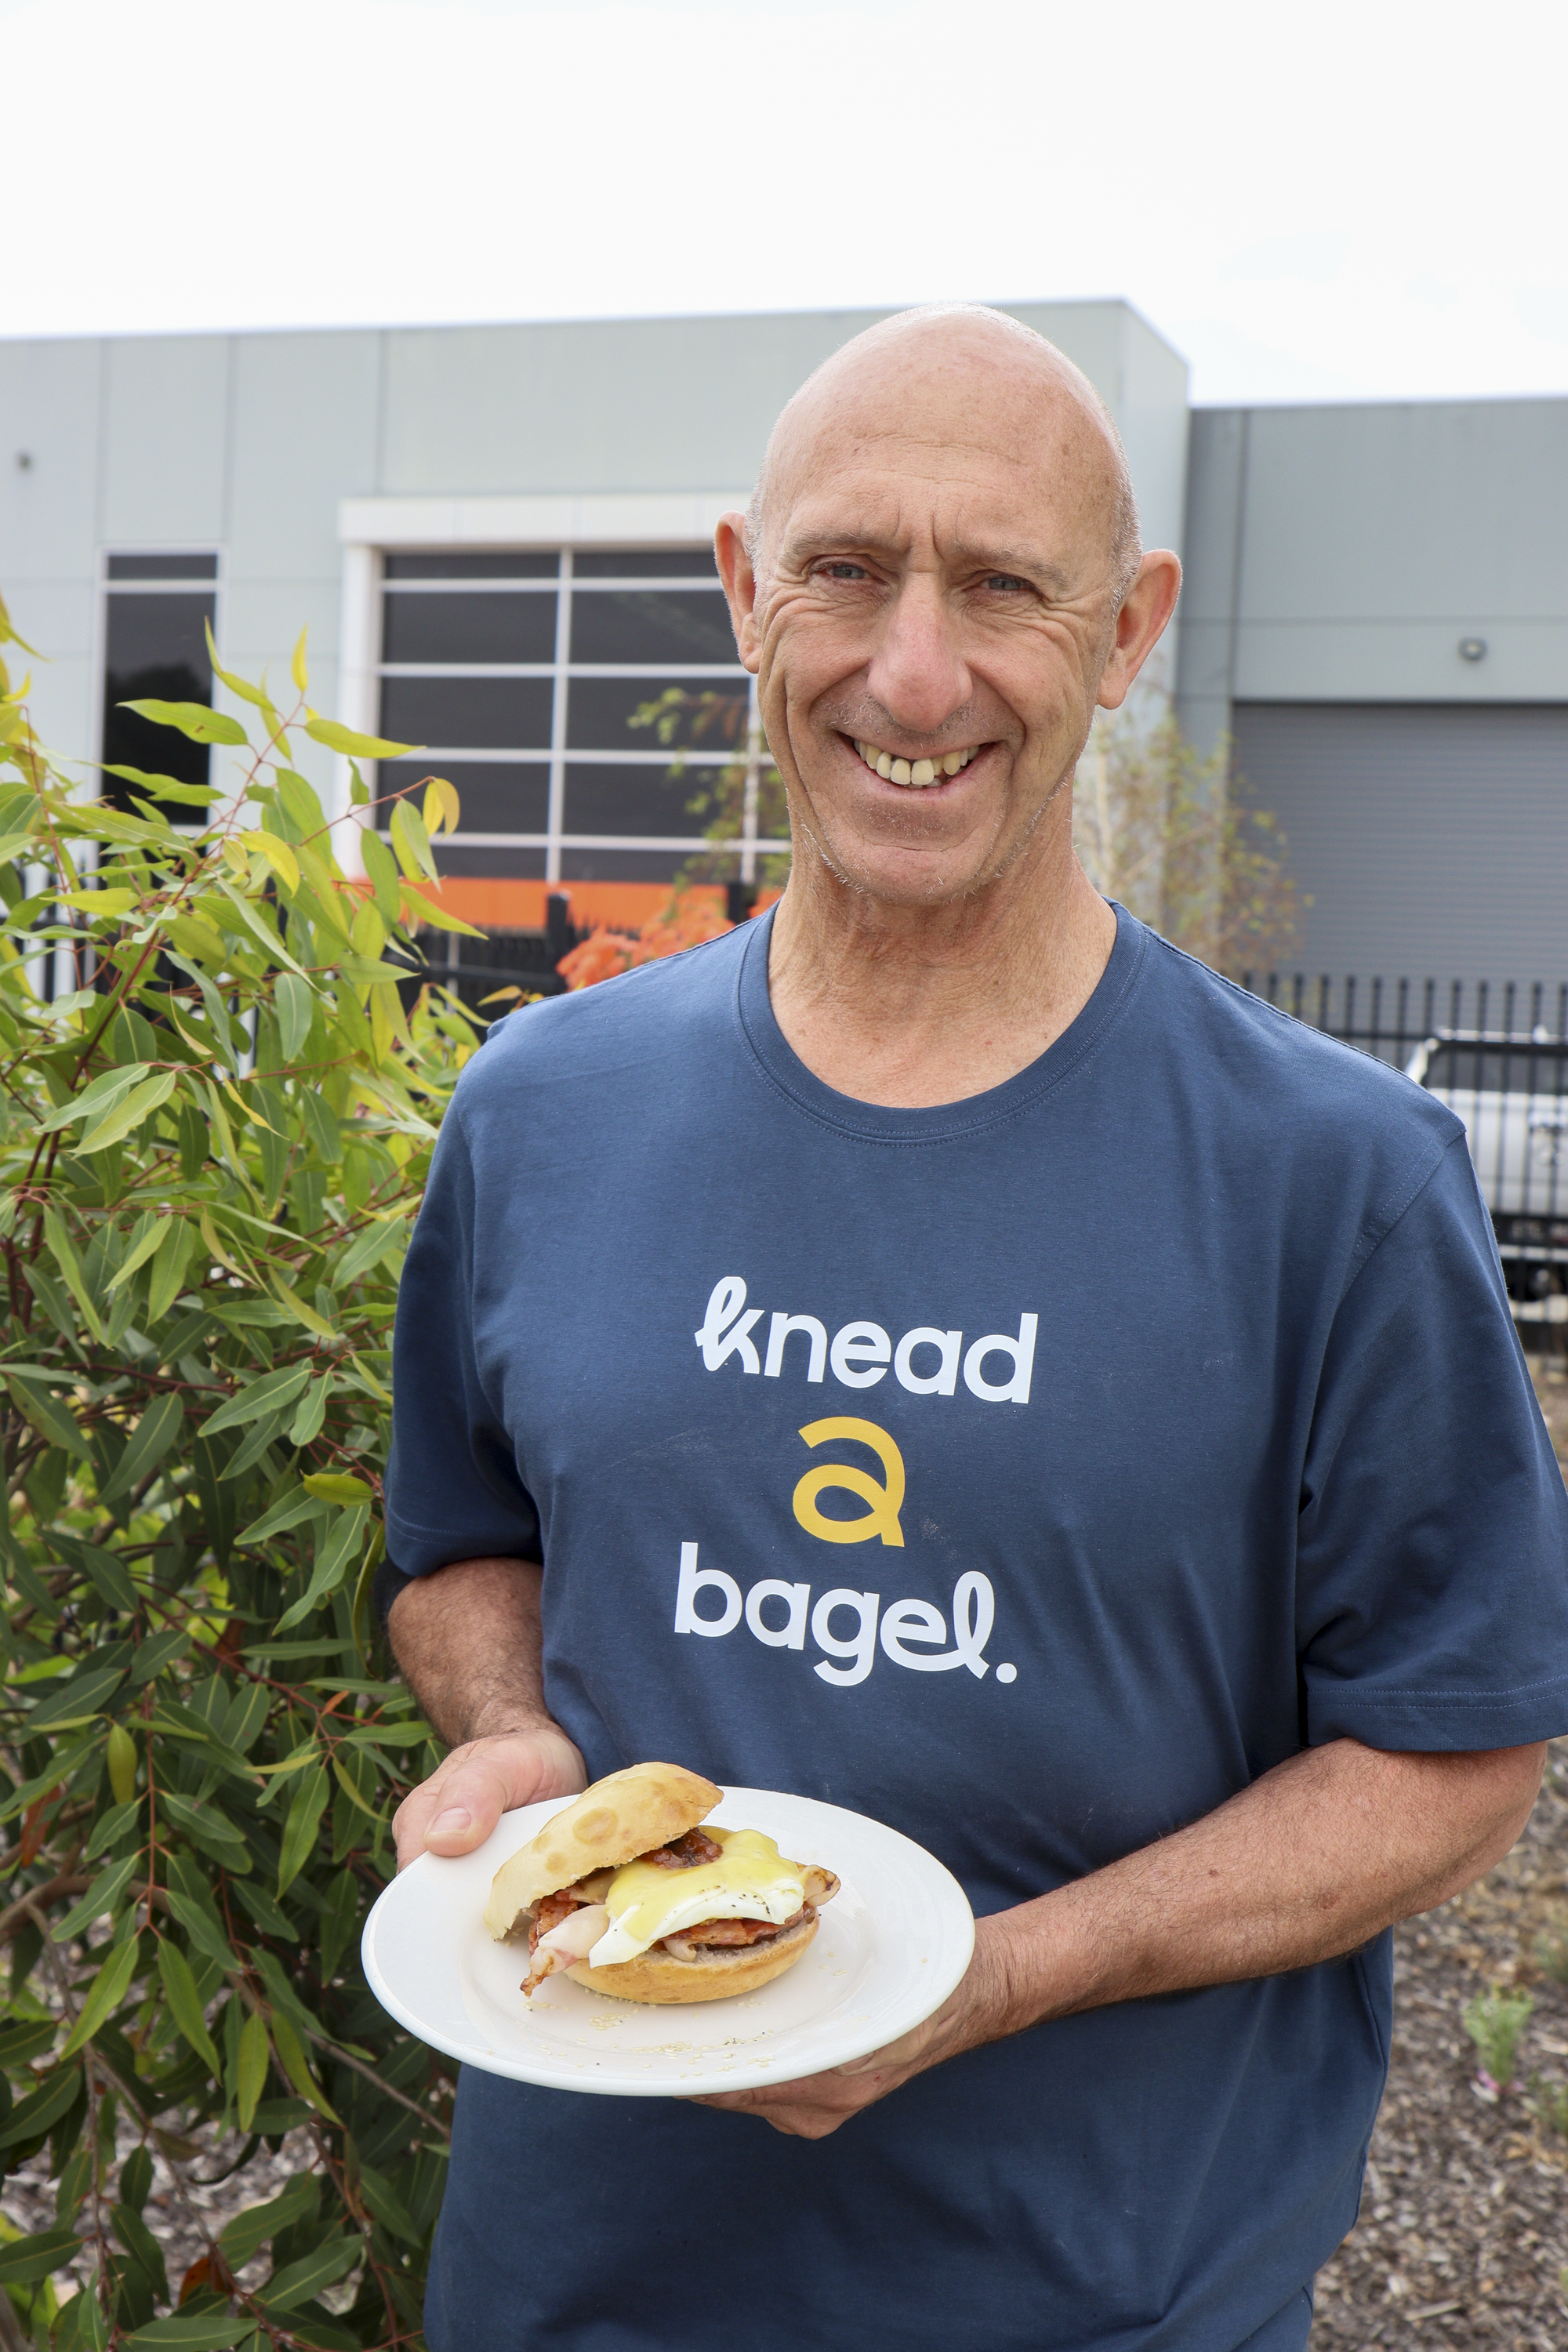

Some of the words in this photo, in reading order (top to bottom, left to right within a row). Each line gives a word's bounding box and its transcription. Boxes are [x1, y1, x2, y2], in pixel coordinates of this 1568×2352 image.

[694, 1276, 1039, 1404] knead
[792, 1416, 906, 1548] a
[674, 1541, 1018, 1687] bagel.
